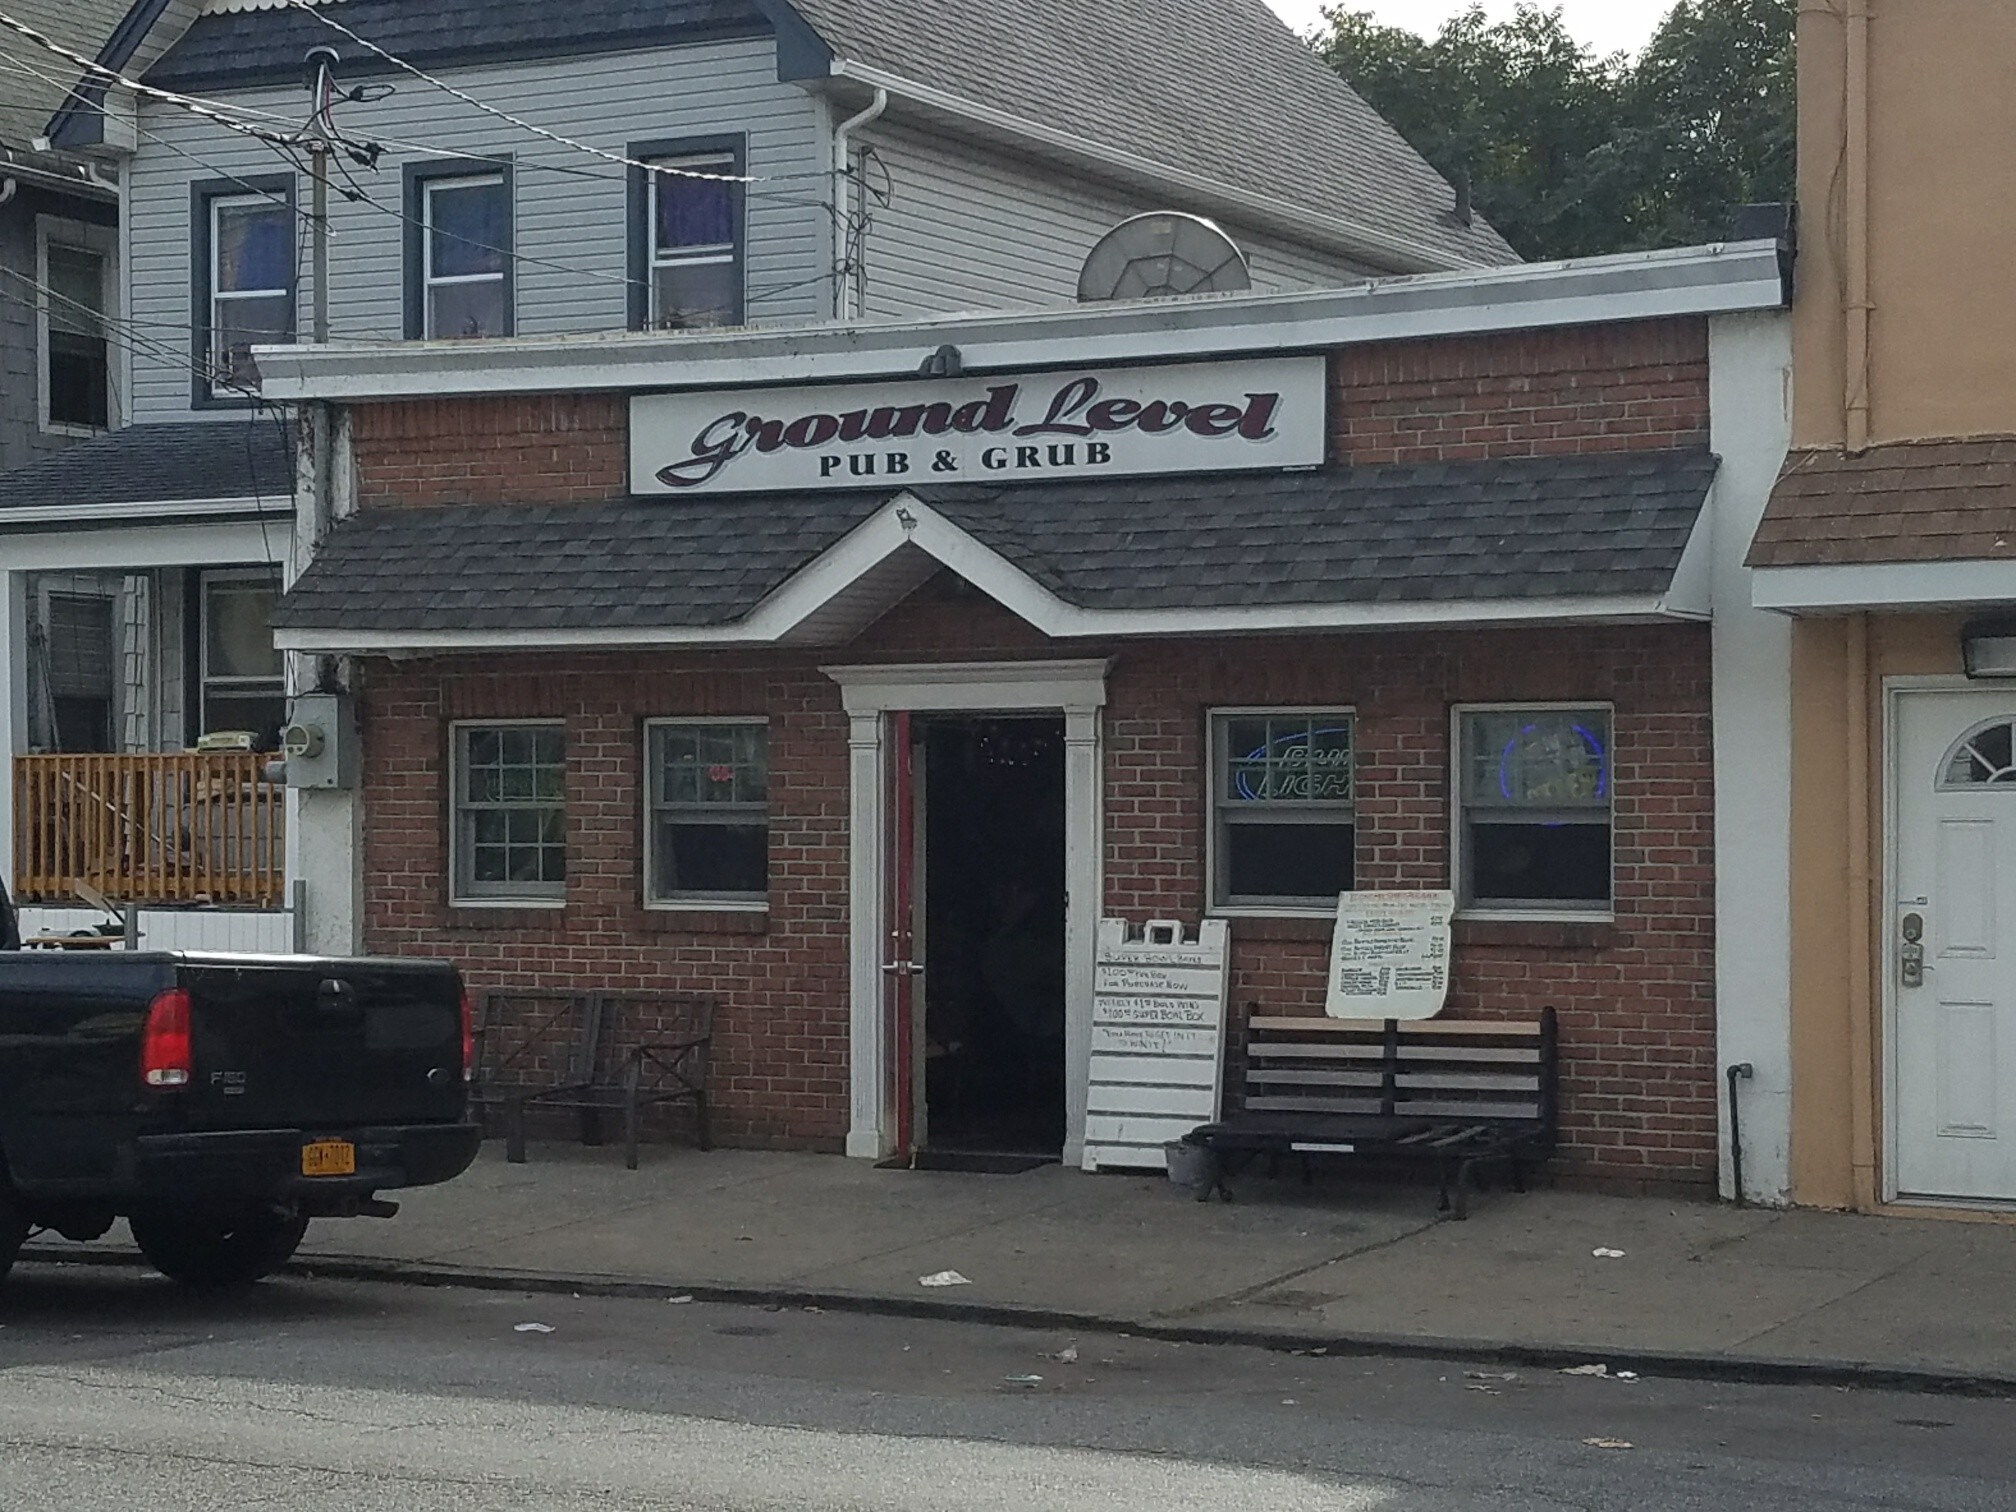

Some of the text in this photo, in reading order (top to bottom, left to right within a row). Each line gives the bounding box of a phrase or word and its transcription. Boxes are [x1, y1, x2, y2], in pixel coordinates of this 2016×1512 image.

[655, 376, 1282, 488] Ground Level
[819, 441, 1113, 478] PUB & GRUB
[1183, 1009, 1206, 1021] BOX
